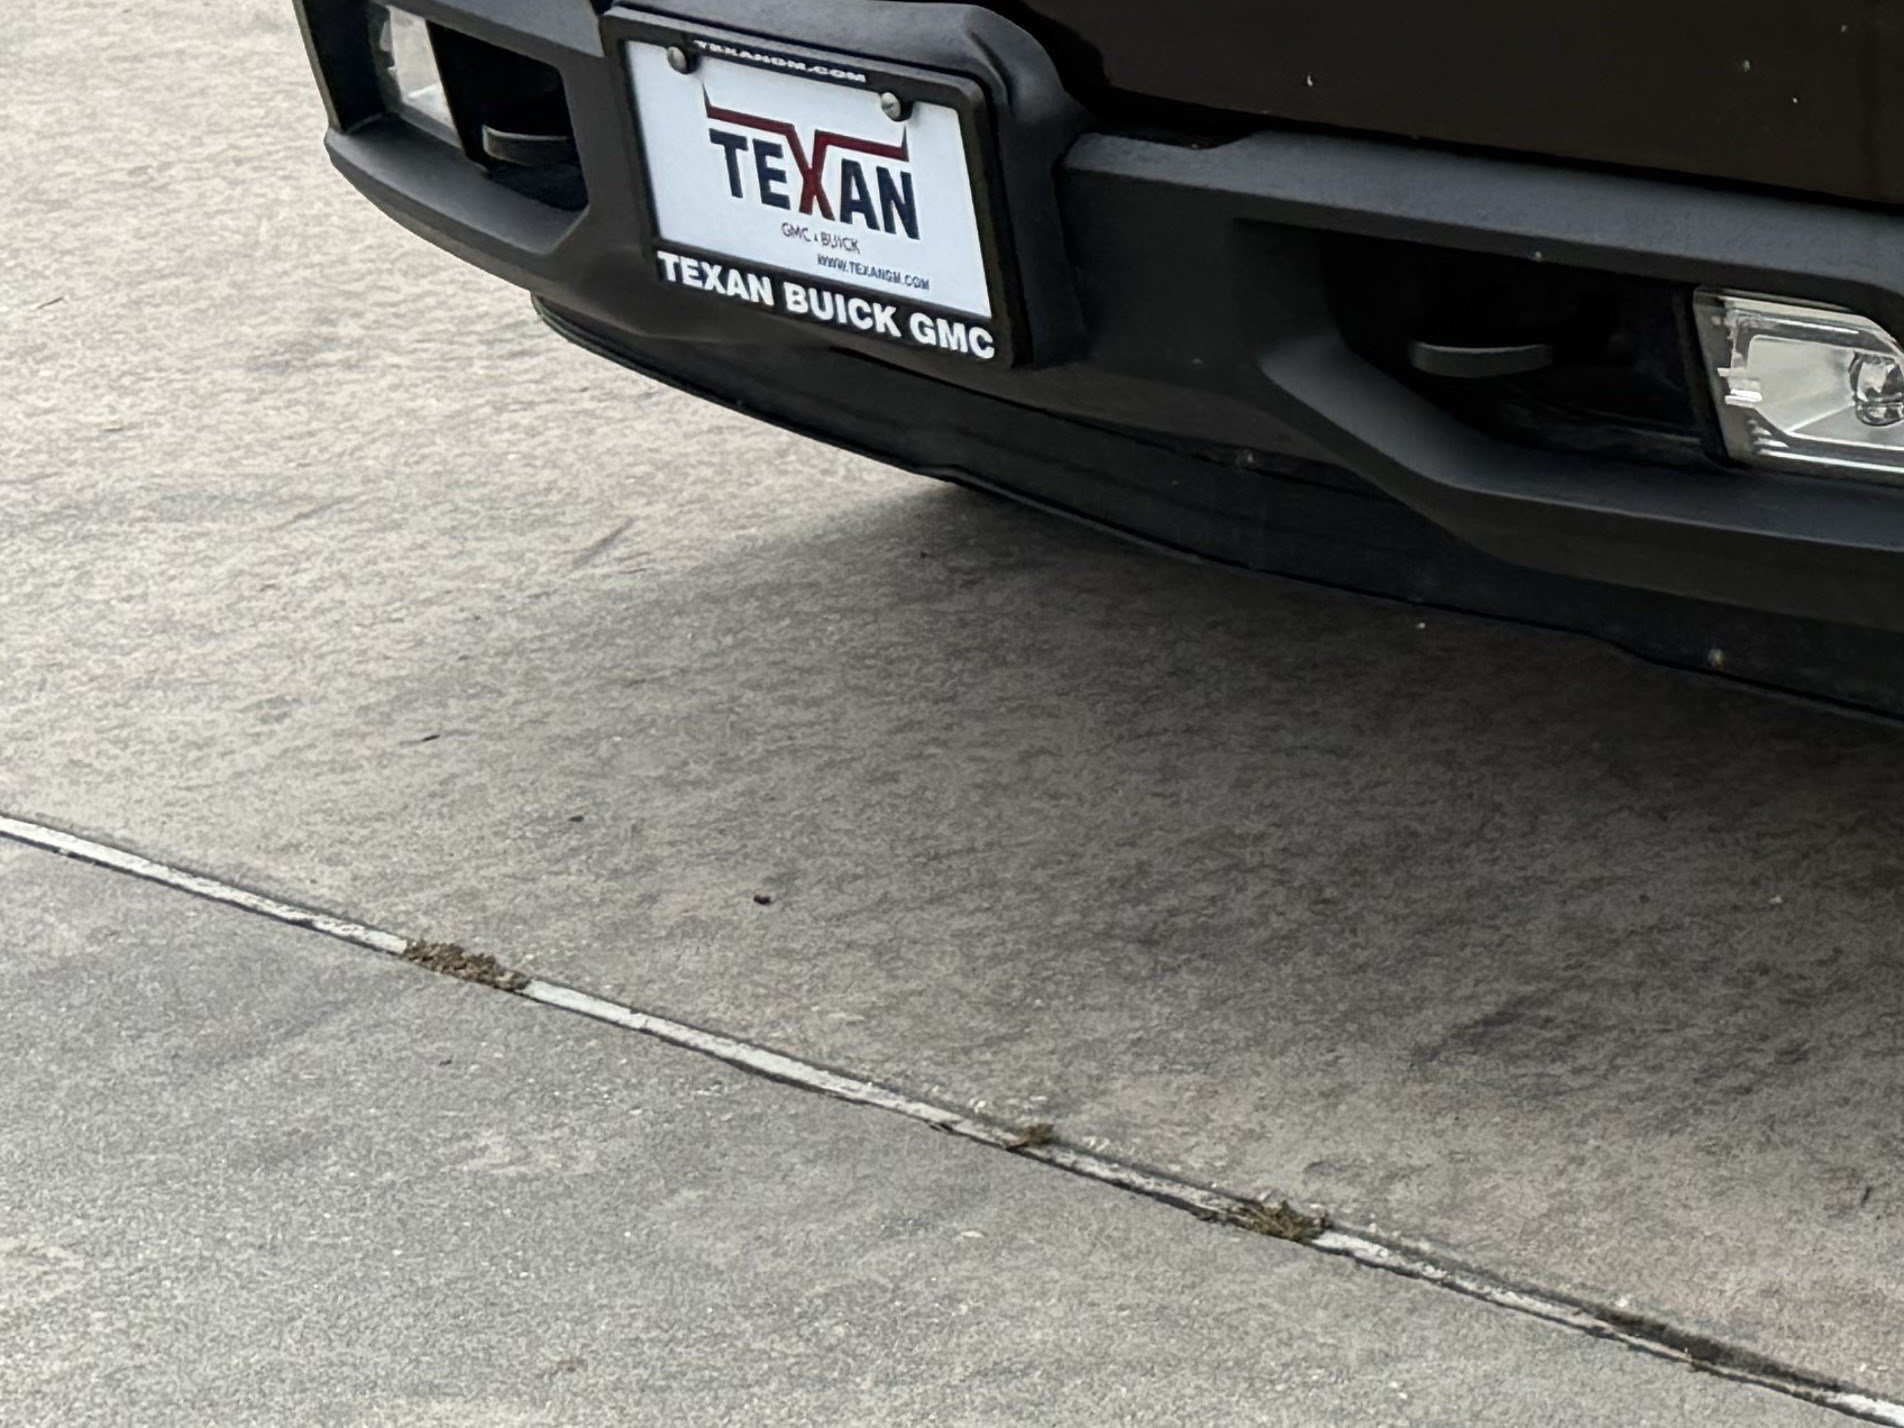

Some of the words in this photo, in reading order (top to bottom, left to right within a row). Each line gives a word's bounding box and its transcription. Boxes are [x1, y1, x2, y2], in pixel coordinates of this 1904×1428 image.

[705, 106, 921, 241] TEXAN
[781, 222, 811, 243] GMC
[820, 231, 861, 254] BUICK
[656, 250, 774, 306] TEXAN
[783, 289, 901, 338] BUICK
[910, 312, 995, 360] GMC
